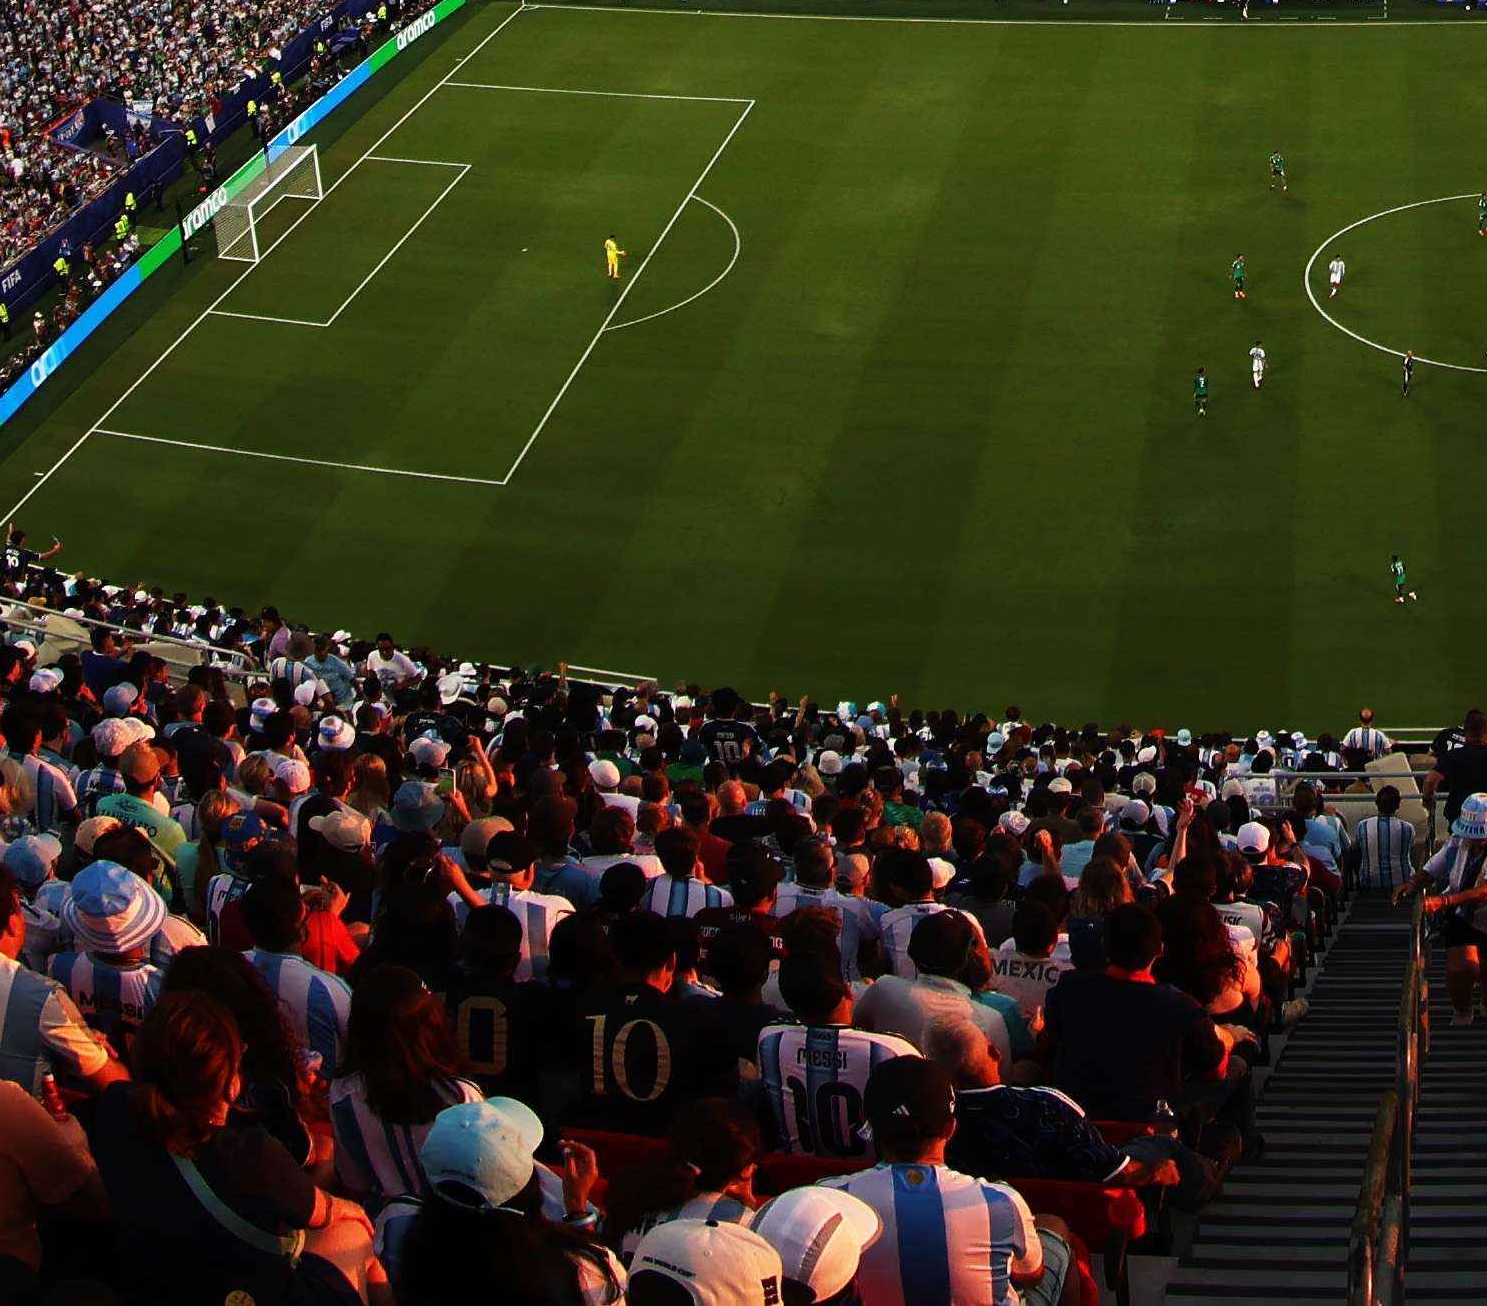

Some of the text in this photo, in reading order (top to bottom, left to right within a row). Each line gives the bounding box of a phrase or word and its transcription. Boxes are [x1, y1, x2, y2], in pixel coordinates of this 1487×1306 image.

[396, 9, 436, 51] aramco
[1, 268, 22, 293] FIFA
[992, 956, 1060, 985] MEXIC
[584, 1014, 672, 1102] 10
[796, 1046, 847, 1070] MESSI
